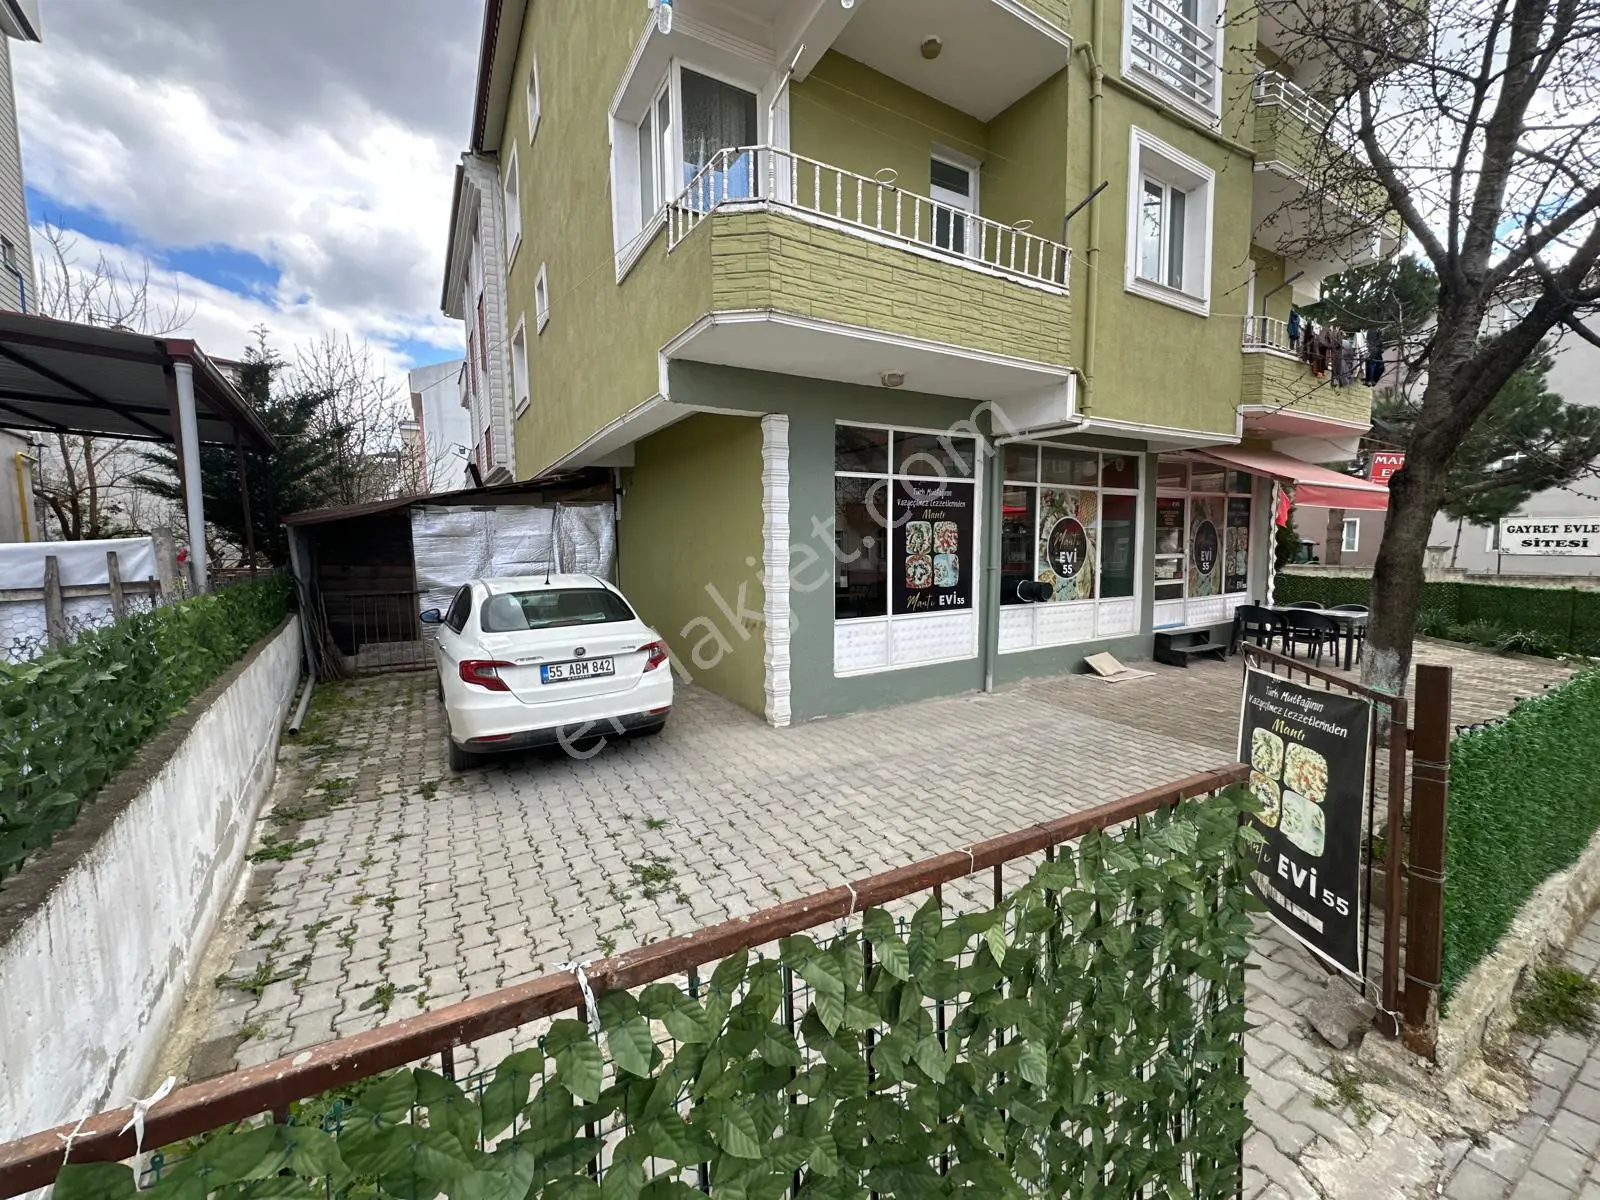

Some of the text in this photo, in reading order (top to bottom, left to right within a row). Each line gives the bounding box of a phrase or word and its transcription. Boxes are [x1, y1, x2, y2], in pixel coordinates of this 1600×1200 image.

[1507, 524, 1600, 534] GAYRET EVLE
[1521, 537, 1589, 548] SİTESİ
[1062, 564, 1073, 574] 55
[549, 666, 563, 678] 55
[569, 662, 589, 676] ABM
[592, 660, 611, 672] 842
[1322, 888, 1349, 916] 55
